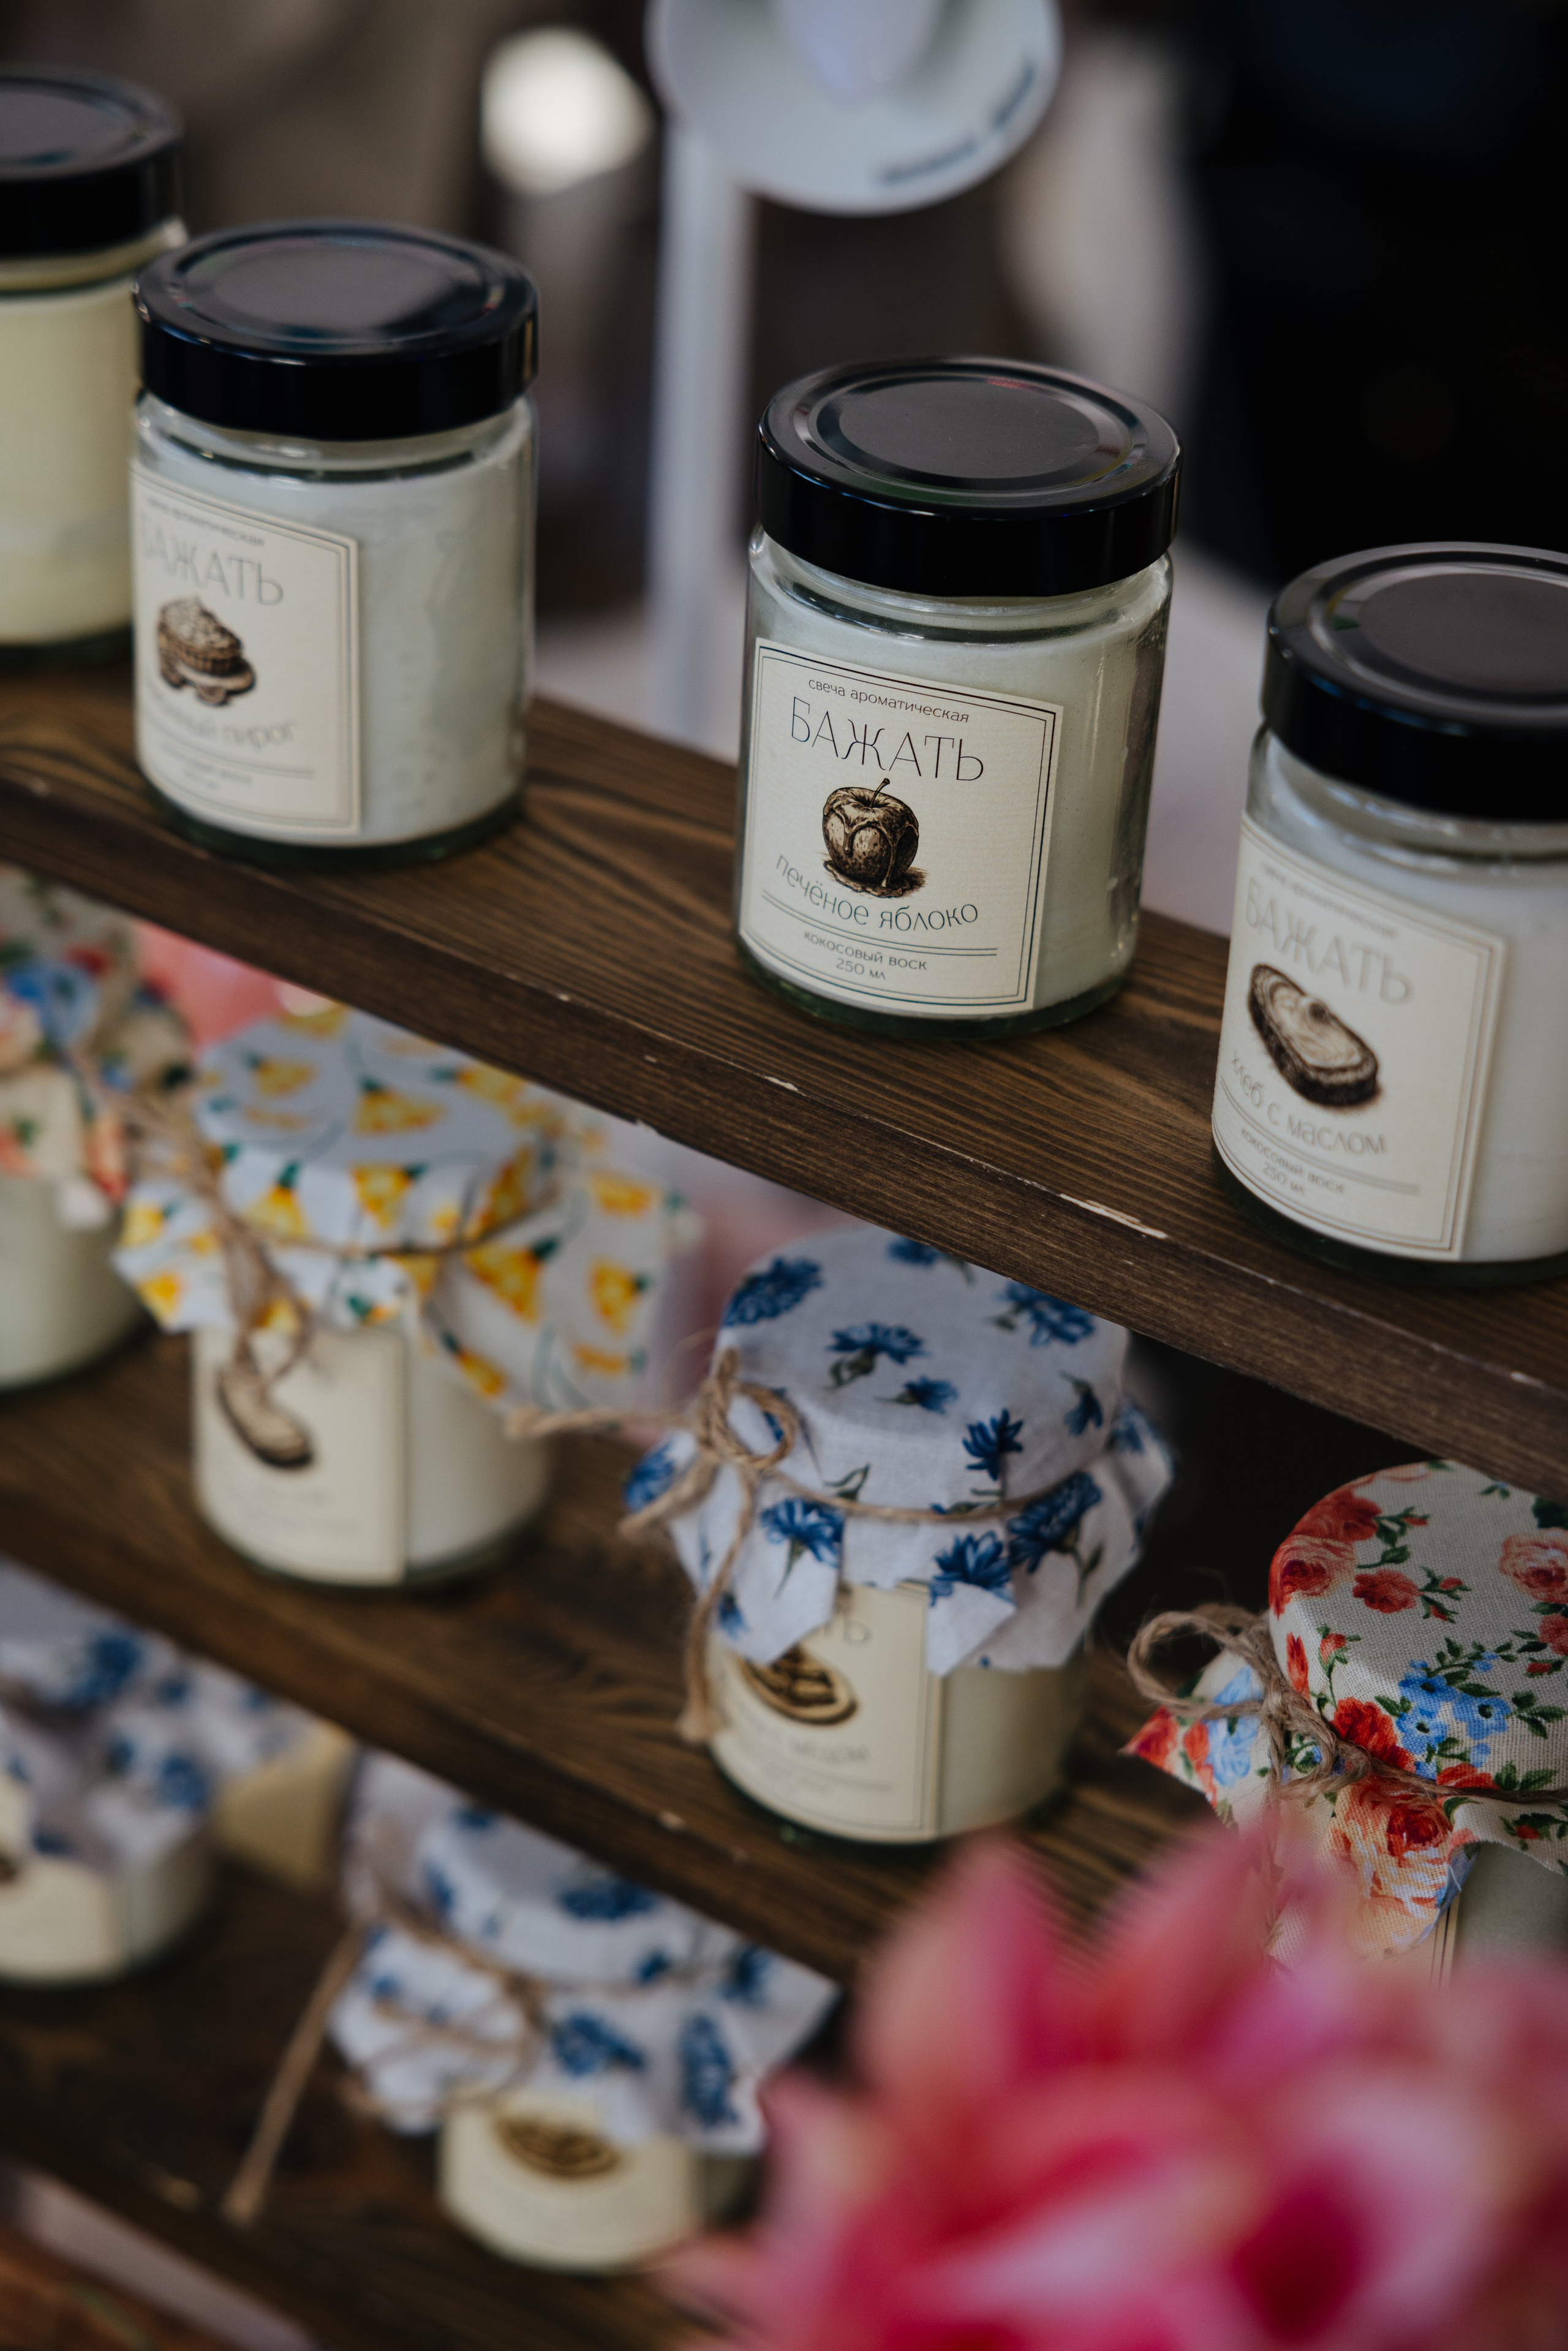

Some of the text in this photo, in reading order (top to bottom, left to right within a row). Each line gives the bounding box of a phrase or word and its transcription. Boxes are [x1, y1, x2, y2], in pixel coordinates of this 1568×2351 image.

[808, 679, 970, 723] свеча ароматическая
[791, 696, 984, 782] БАЖАТЬ
[775, 855, 978, 932] печёное яблоко
[803, 930, 929, 972] кокосовый воск
[835, 957, 886, 981] 250 мл
[1285, 1114, 1389, 1155] маслом
